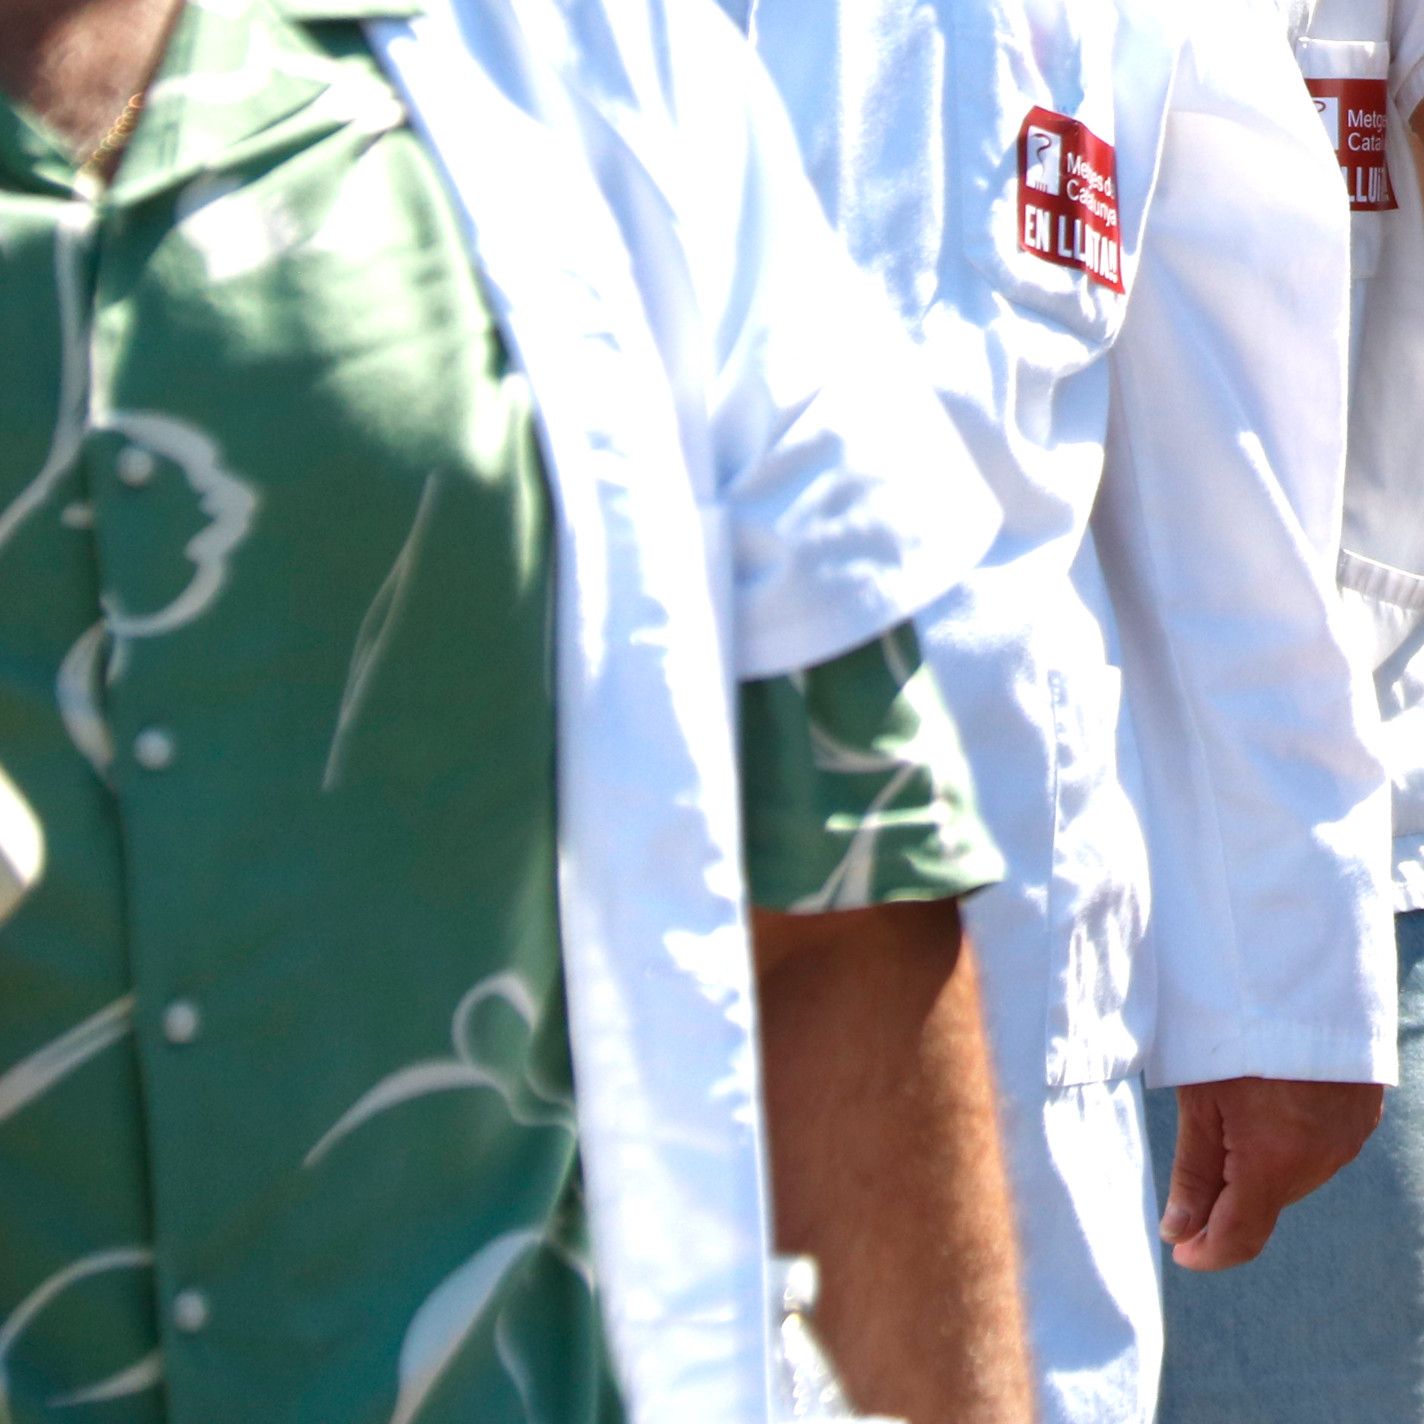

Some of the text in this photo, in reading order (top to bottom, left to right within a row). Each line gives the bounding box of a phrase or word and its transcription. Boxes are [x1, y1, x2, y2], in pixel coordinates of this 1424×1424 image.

[1346, 108, 1389, 133] Metg
[1347, 131, 1386, 151] Cata
[1024, 204, 1051, 253] EN
